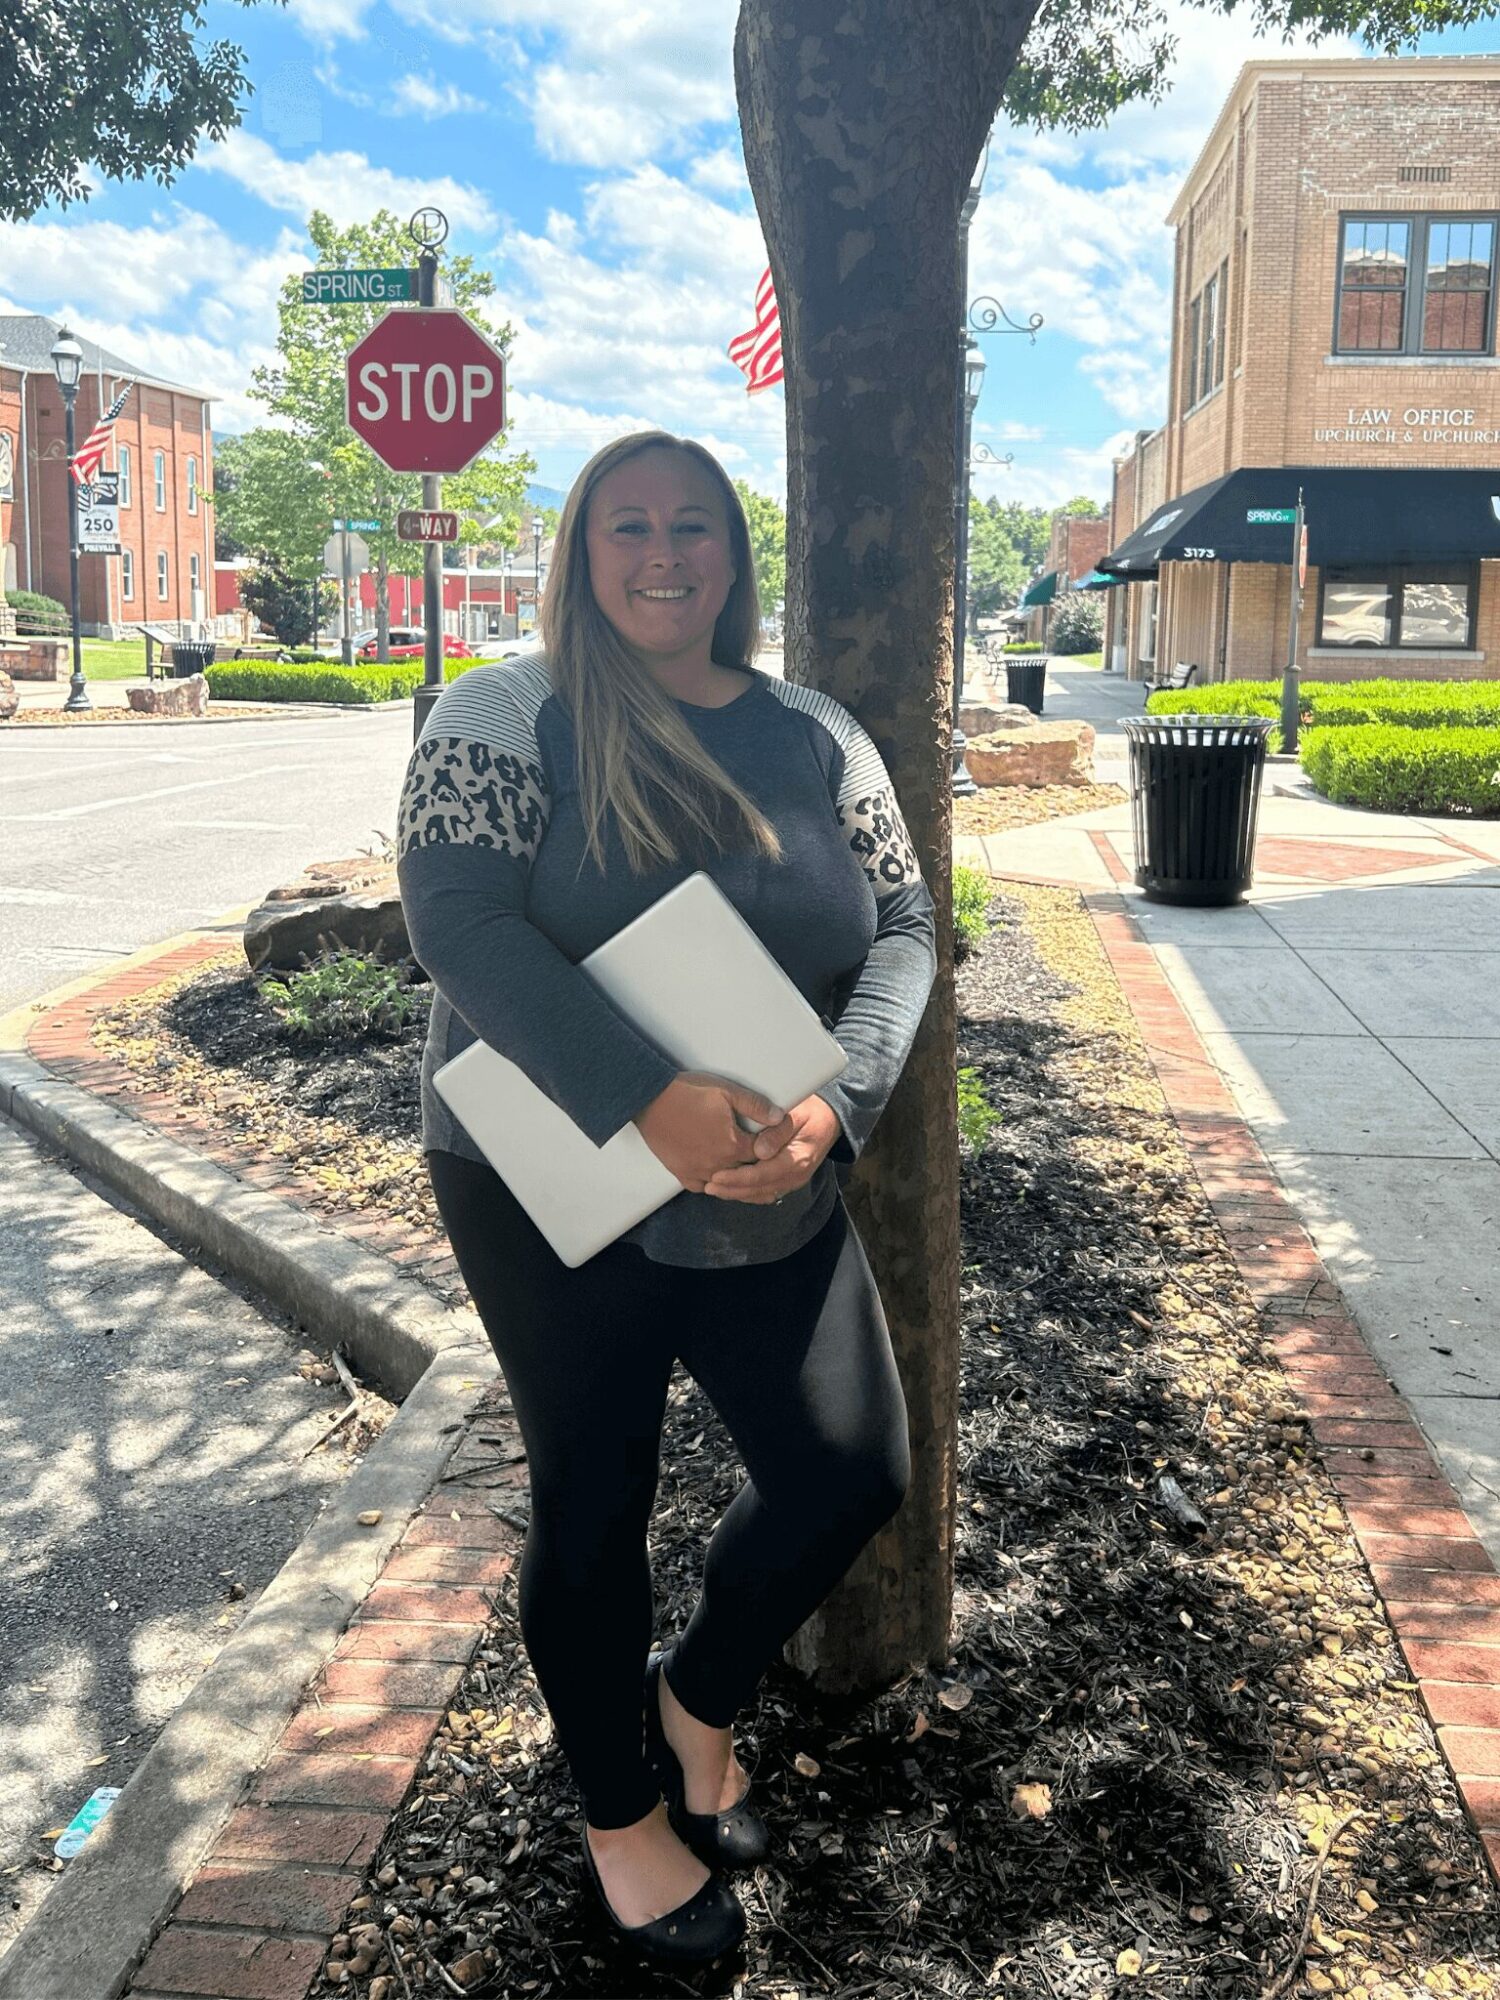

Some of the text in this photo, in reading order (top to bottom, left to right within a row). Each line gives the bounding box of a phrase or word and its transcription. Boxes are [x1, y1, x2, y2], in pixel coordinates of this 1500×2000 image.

[303, 273, 404, 299] SPRING ST.
[357, 362, 494, 423] STOP
[1348, 408, 1475, 426] LAW OFFICE
[1314, 429, 1396, 443] UPCHURCH
[1403, 430, 1413, 443] &
[1247, 510, 1283, 522] SPRING
[84, 518, 114, 531] 250
[403, 517, 452, 536] 4-WAY
[1184, 547, 1215, 559] 3173
